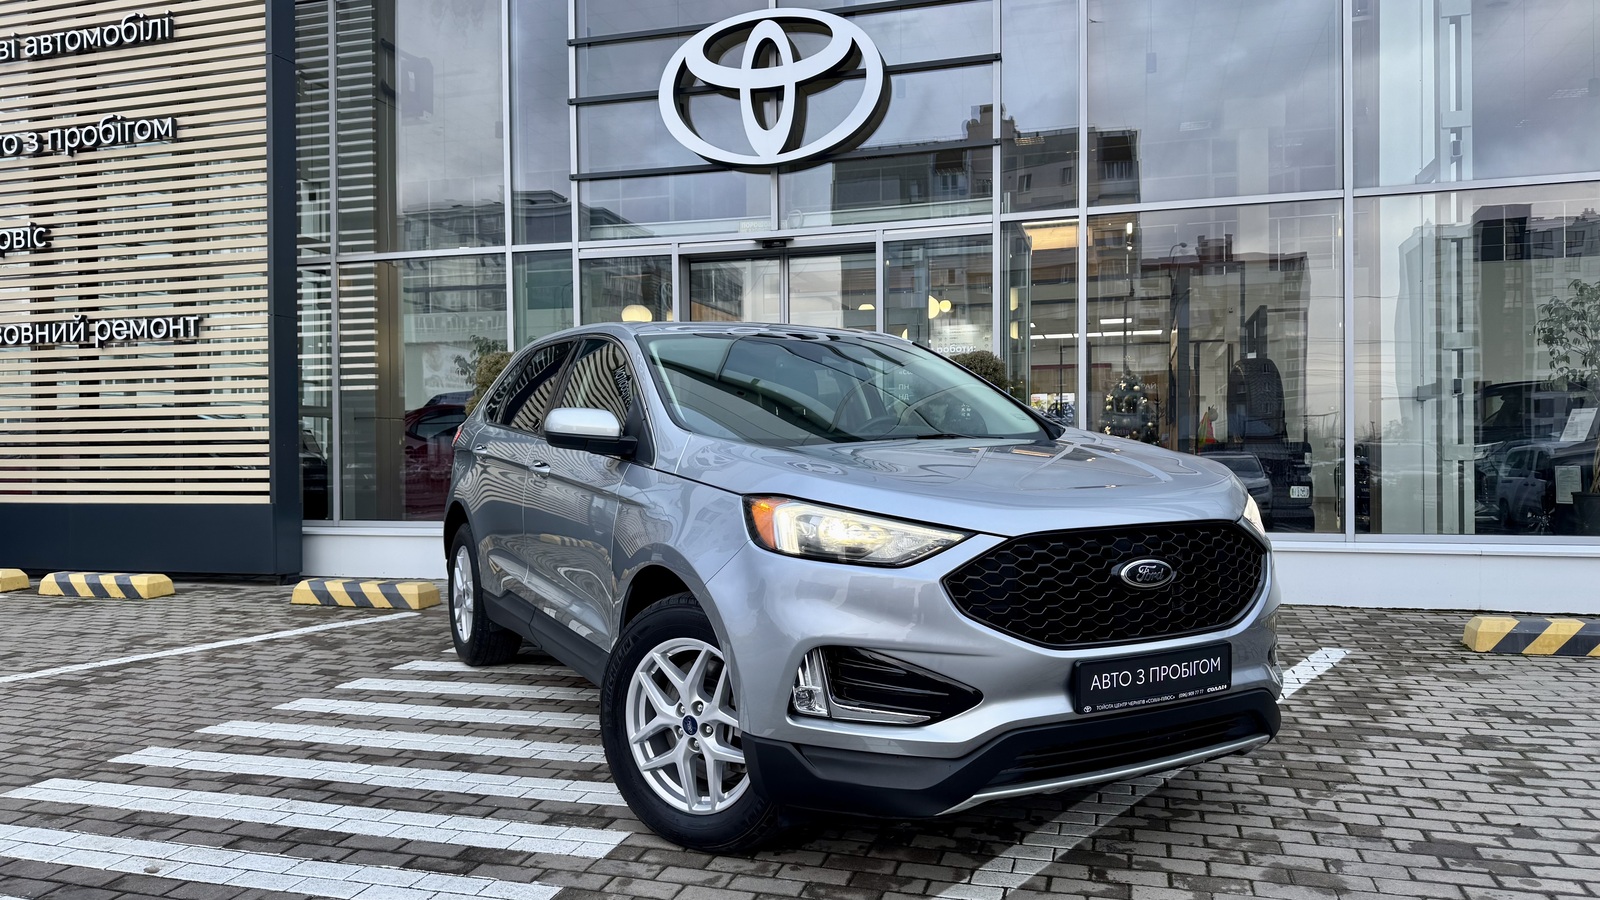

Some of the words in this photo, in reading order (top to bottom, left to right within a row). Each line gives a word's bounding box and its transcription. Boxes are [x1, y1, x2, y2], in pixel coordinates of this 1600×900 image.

[25, 10, 172, 57] автомобілі
[26, 132, 39, 153] з
[48, 115, 174, 156] пробігом
[95, 316, 199, 348] ремонт
[936, 344, 976, 354] роботи:
[898, 393, 910, 401] НД
[1136, 565, 1164, 582] Ford
[1090, 670, 1132, 691] АВТО
[1136, 668, 1146, 685] З
[1149, 656, 1221, 683] ПРОБІГОМ
[1096, 703, 1113, 711] ТОЙОТА
[1114, 701, 1128, 709] ЦЕНТР
